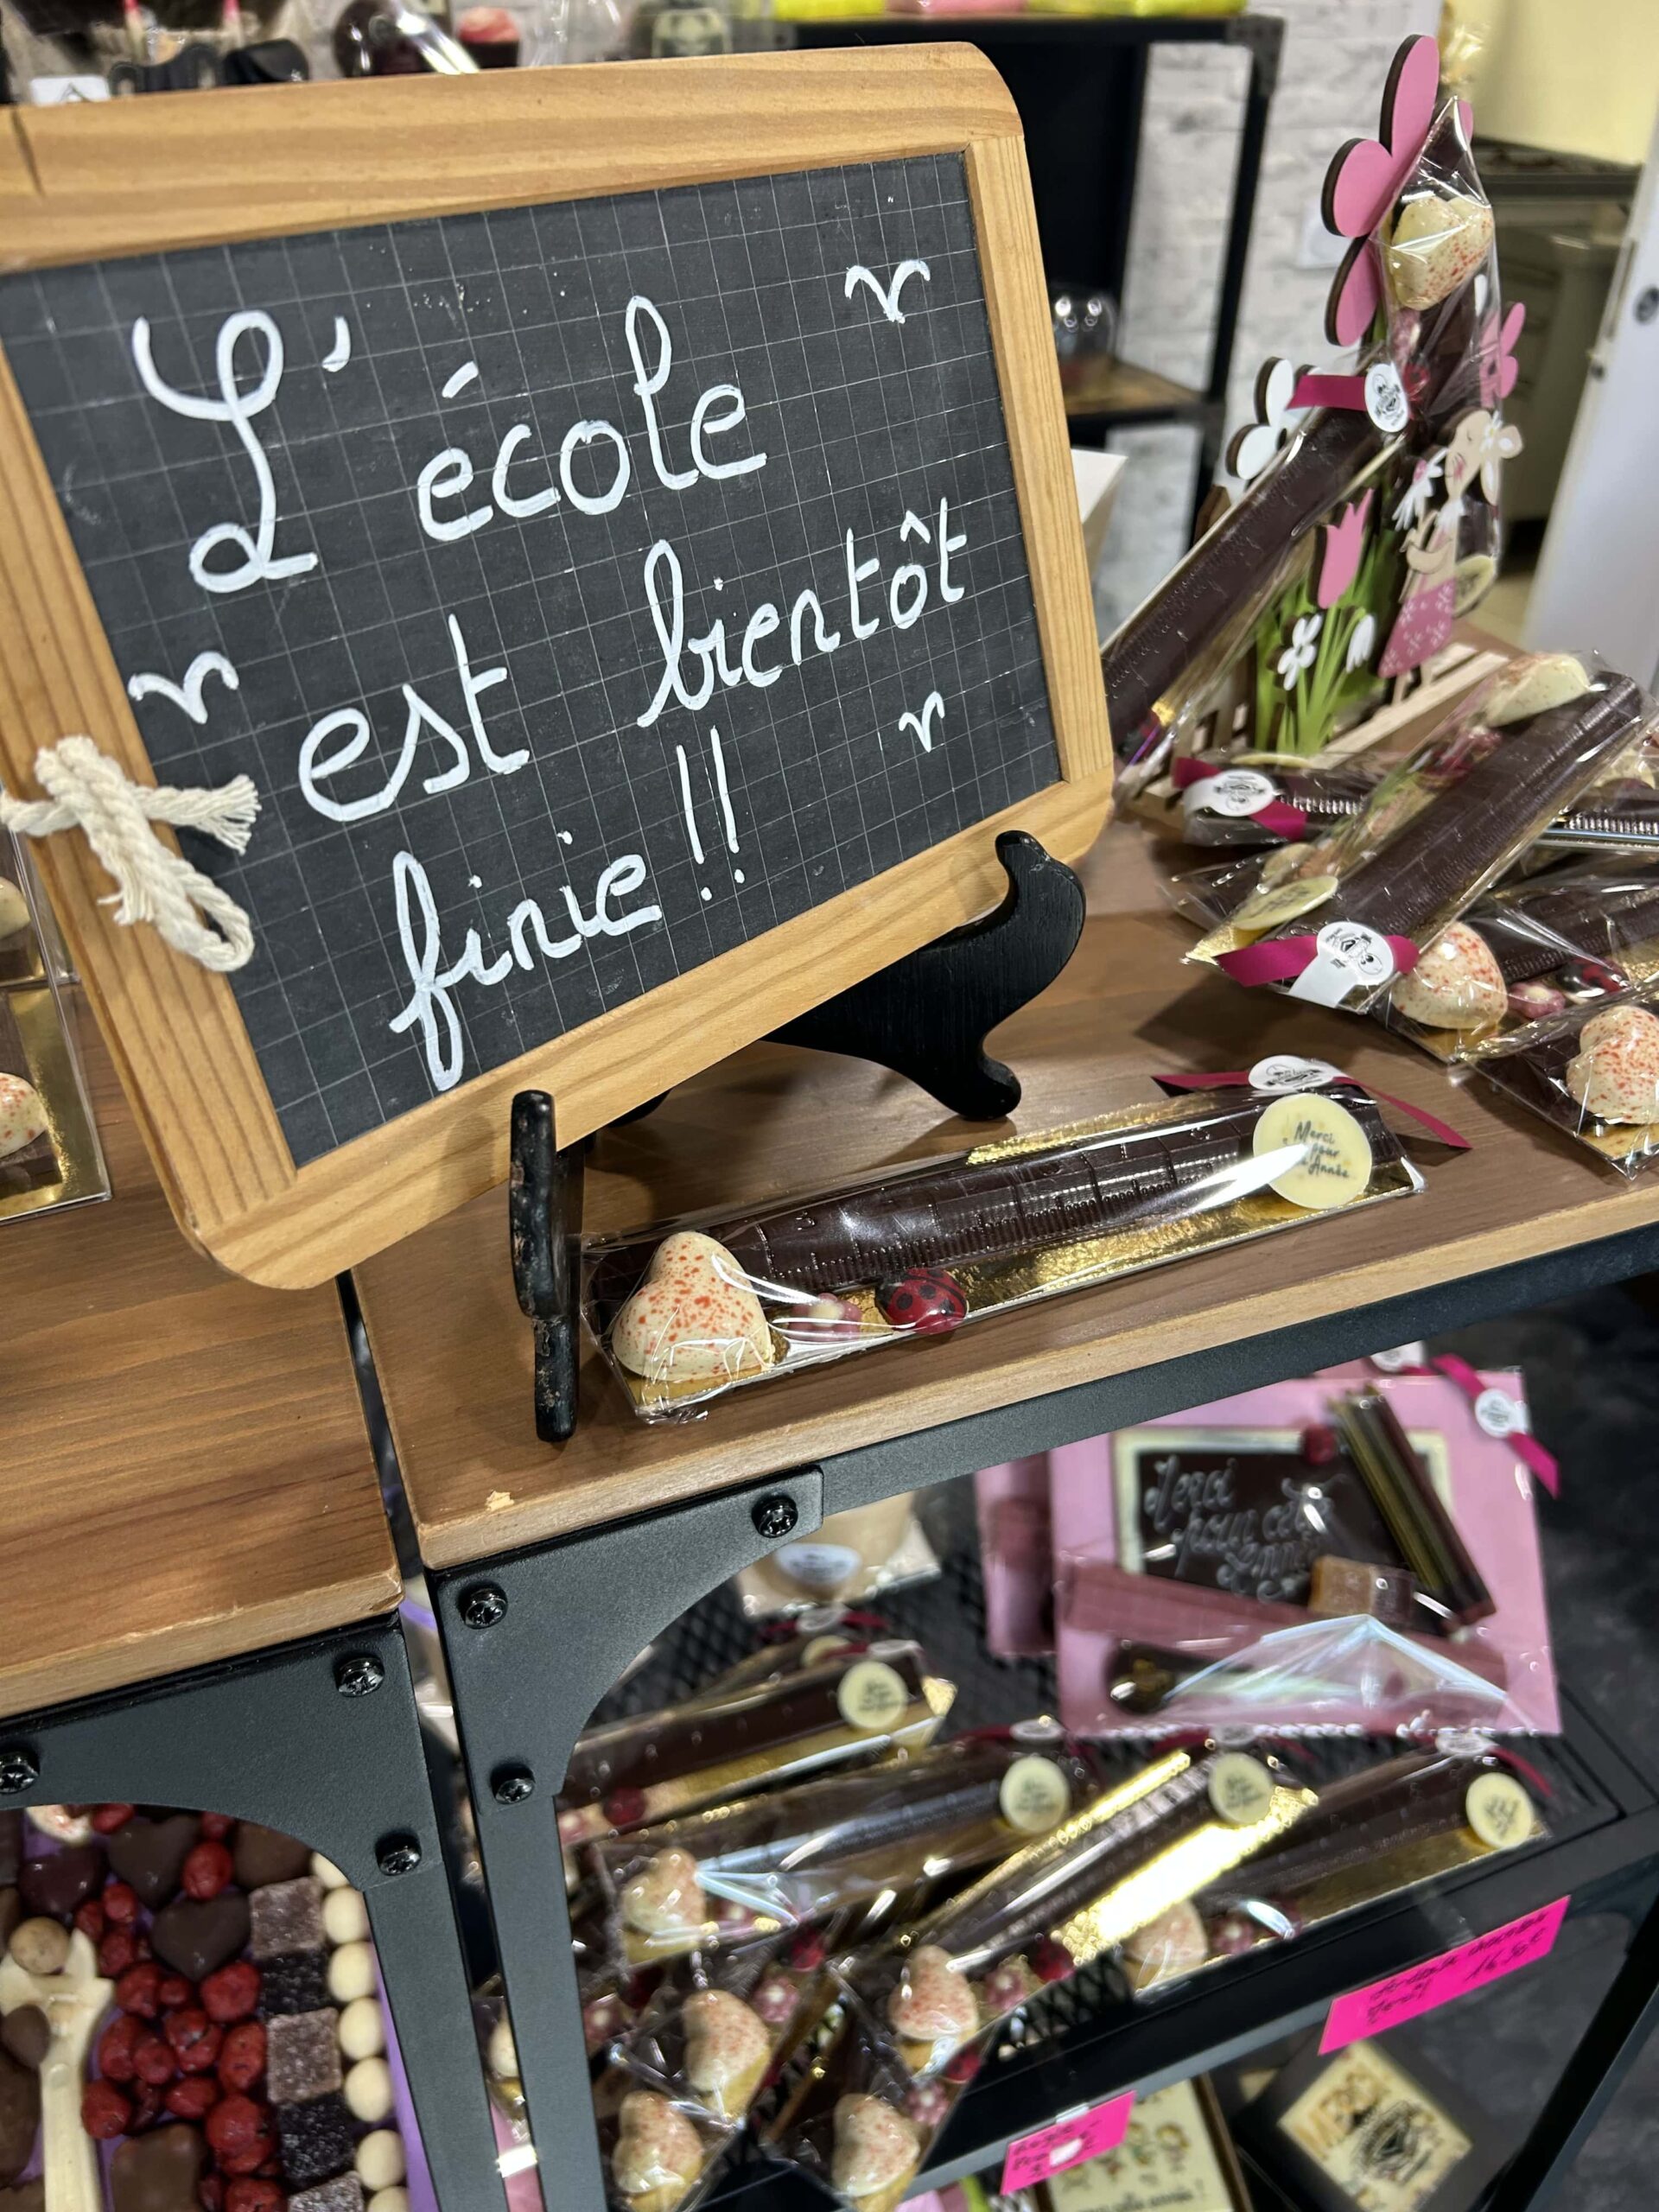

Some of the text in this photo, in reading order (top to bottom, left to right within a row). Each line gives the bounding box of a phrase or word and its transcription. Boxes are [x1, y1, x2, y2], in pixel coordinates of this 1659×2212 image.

[298, 497, 968, 823] est bientôt
[1294, 1120, 1336, 1145] Merci
[1309, 1142, 1340, 1161] pour
